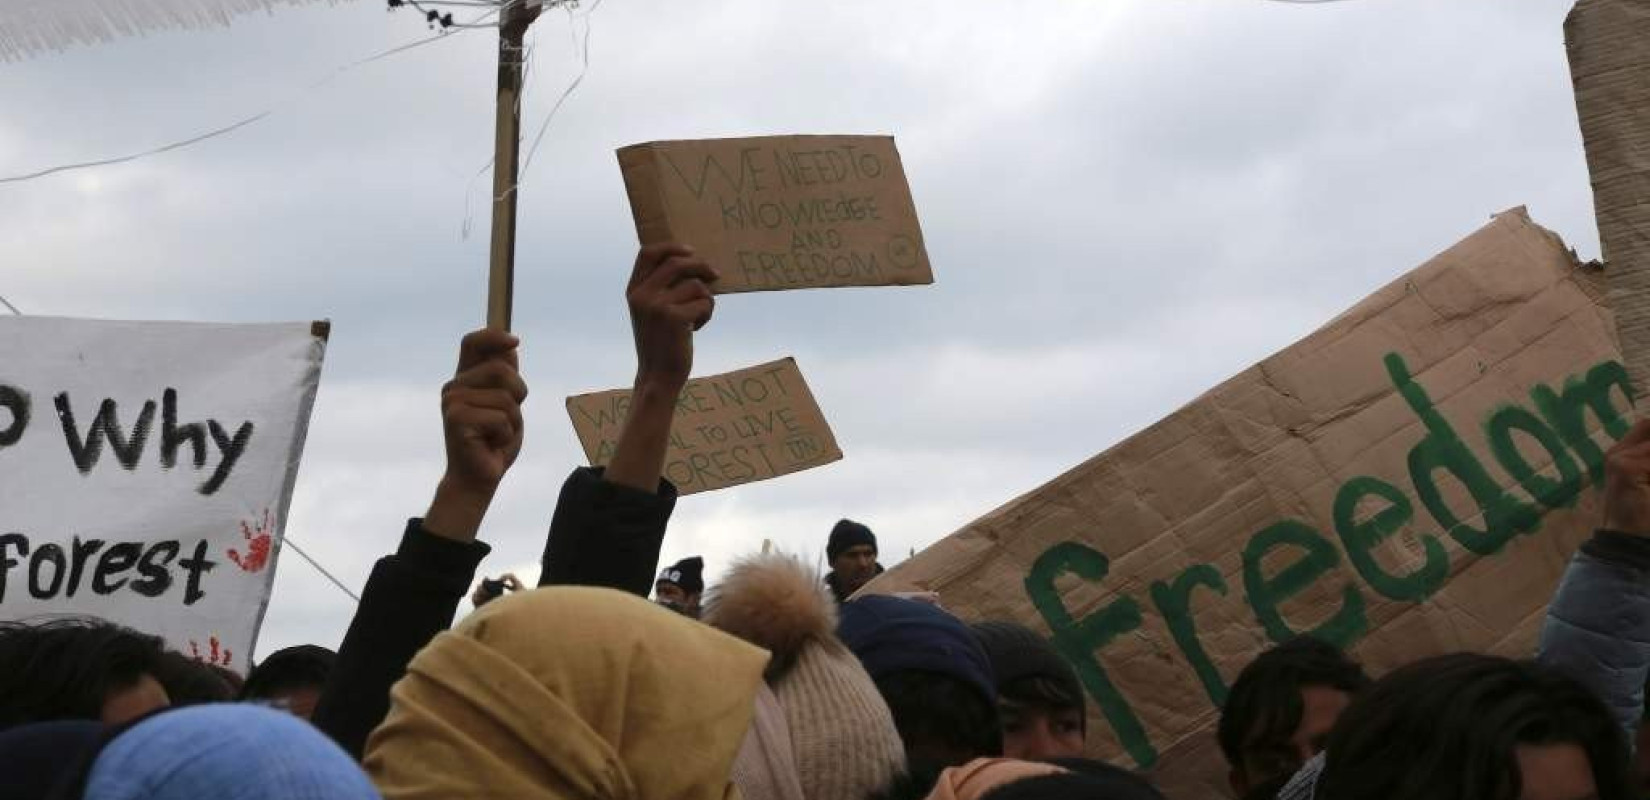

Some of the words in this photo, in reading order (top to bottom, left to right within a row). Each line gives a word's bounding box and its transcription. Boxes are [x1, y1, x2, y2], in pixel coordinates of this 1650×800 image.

[660, 146, 765, 200] WE
[736, 250, 883, 287] FREEDOM
[672, 382, 716, 416] RE
[710, 366, 787, 408] NOT
[54, 386, 254, 496] Why
[731, 406, 798, 439] LIVE
[666, 443, 777, 488] OREST
